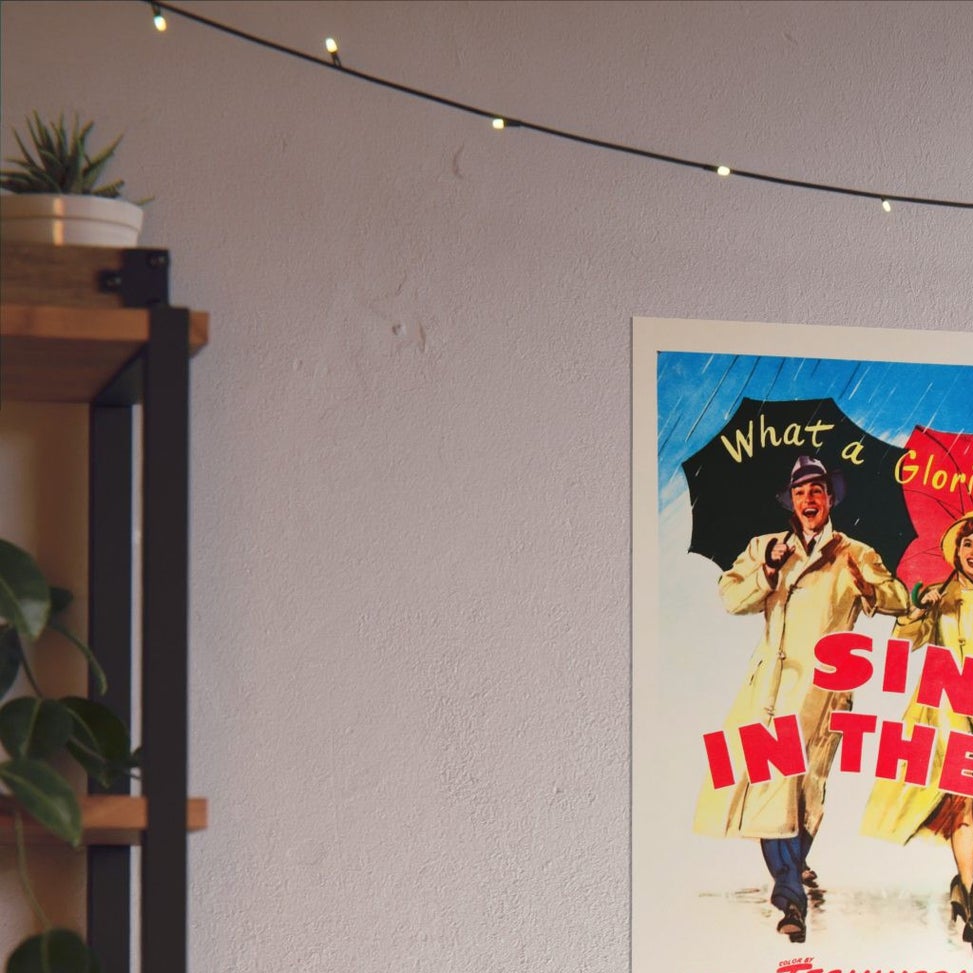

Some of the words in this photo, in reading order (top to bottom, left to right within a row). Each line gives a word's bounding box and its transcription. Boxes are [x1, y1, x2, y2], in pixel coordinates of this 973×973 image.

[721, 413, 835, 463] What
[842, 441, 866, 465] a
[703, 716, 806, 790] IN
